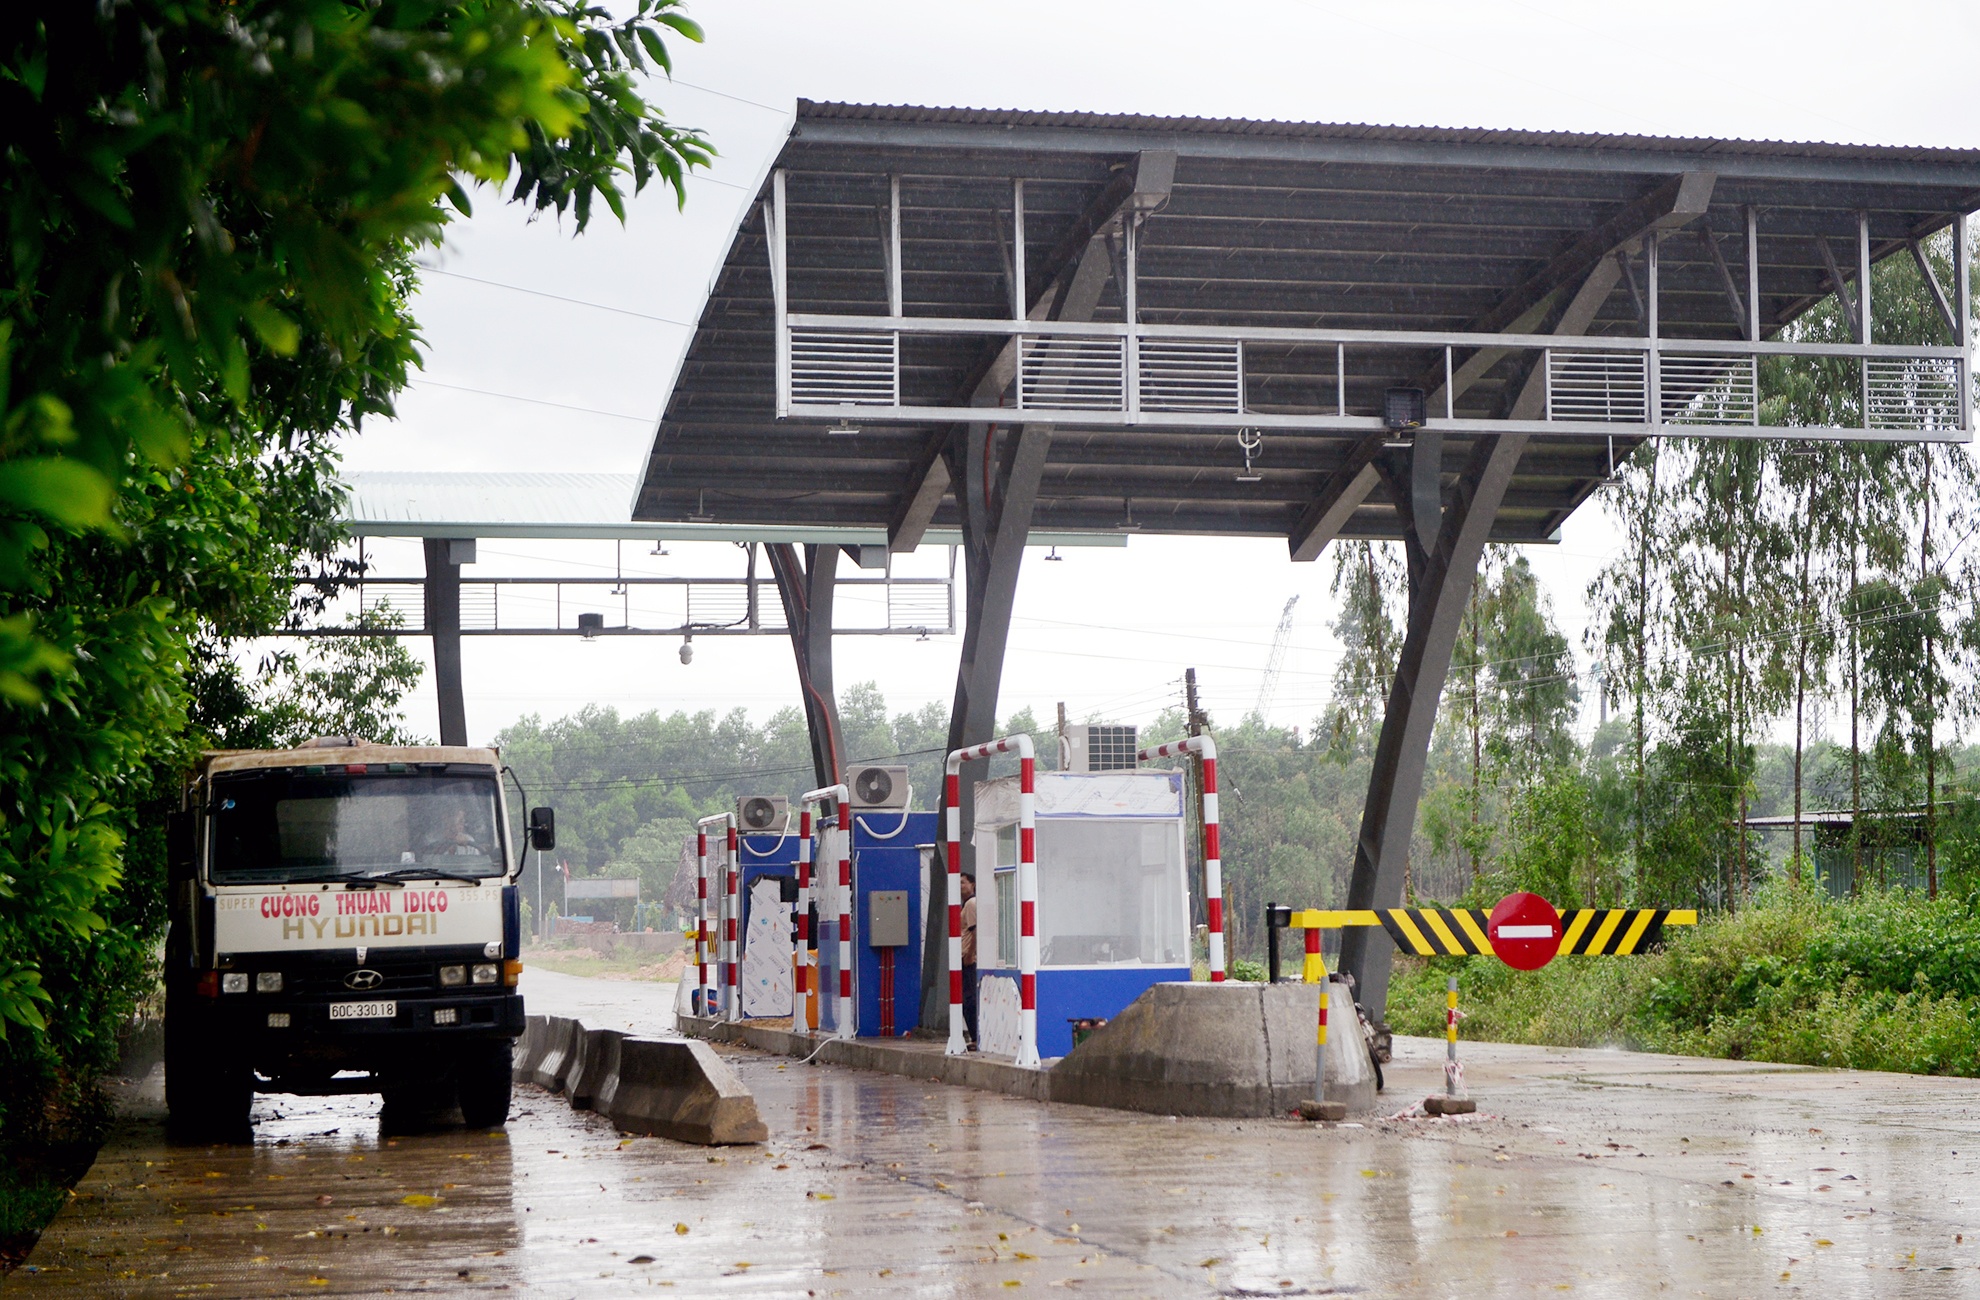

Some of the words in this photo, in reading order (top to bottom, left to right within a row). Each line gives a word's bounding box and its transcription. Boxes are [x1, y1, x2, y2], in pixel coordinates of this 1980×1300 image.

[220, 897, 255, 910] SUPER
[403, 890, 449, 913] IDICO
[282, 914, 437, 940] HYUNDAI
[332, 1003, 394, 1018] 60C-330.18
